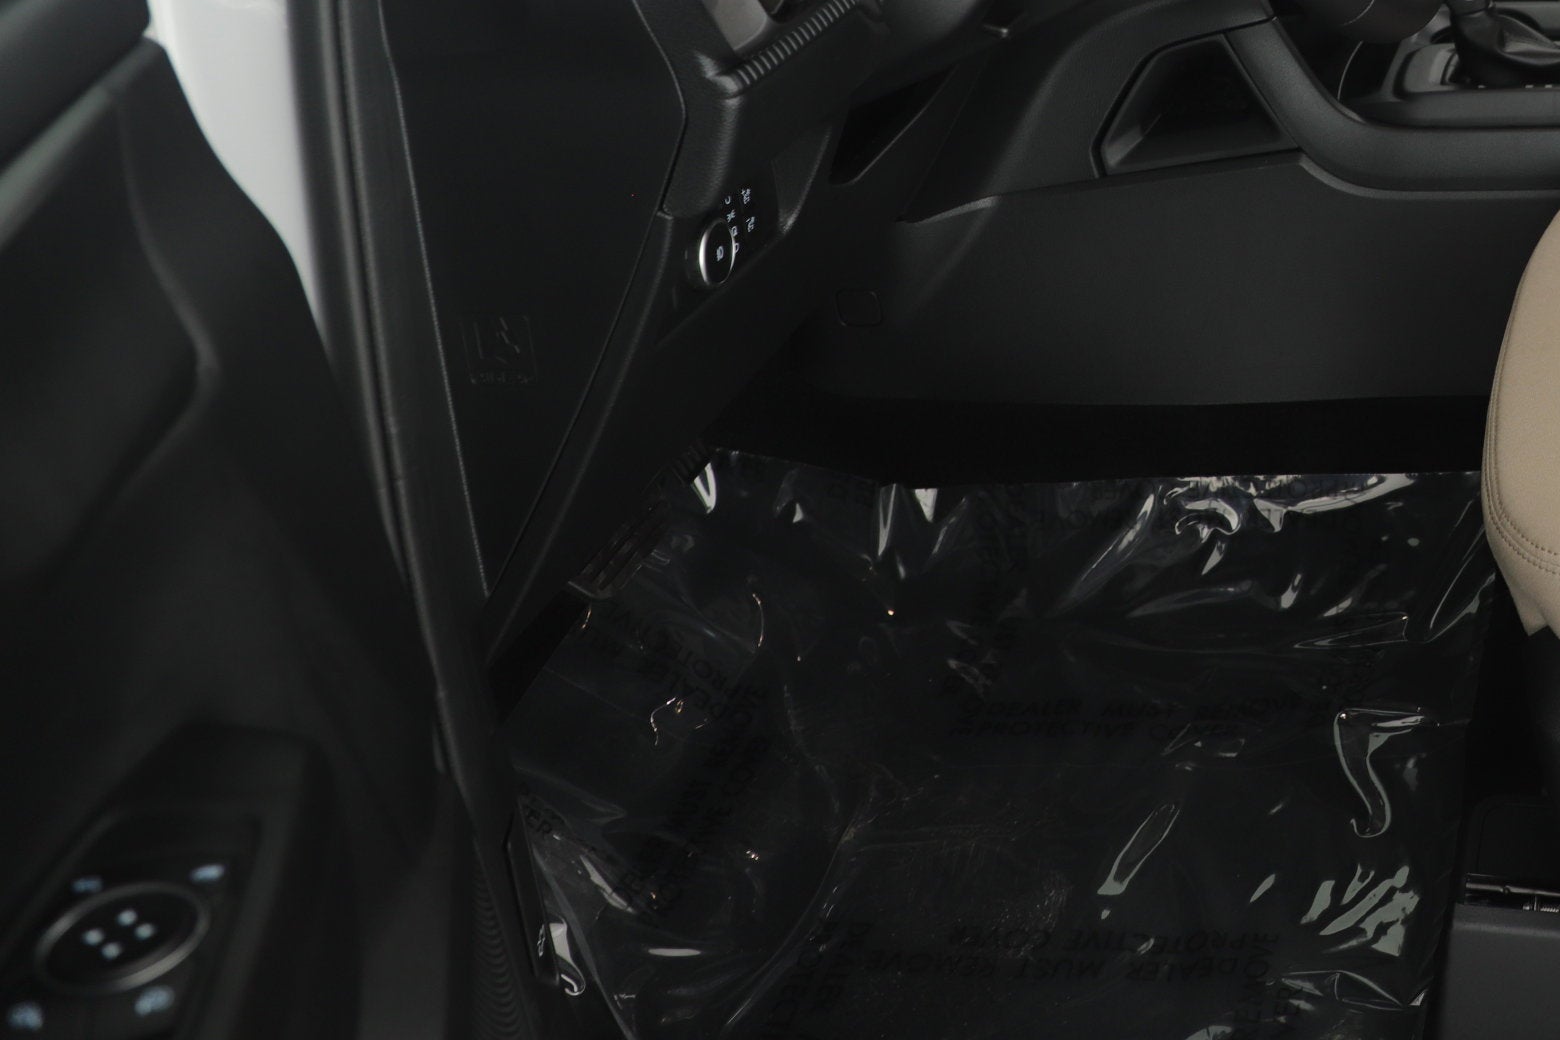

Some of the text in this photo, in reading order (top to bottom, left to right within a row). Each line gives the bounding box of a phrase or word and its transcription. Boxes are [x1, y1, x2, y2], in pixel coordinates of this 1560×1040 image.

[986, 697, 1083, 718] DEALER
[1063, 929, 1251, 953] PROTECTIVE
[1015, 956, 1106, 982] MUST
[1125, 955, 1240, 984] DEALER
